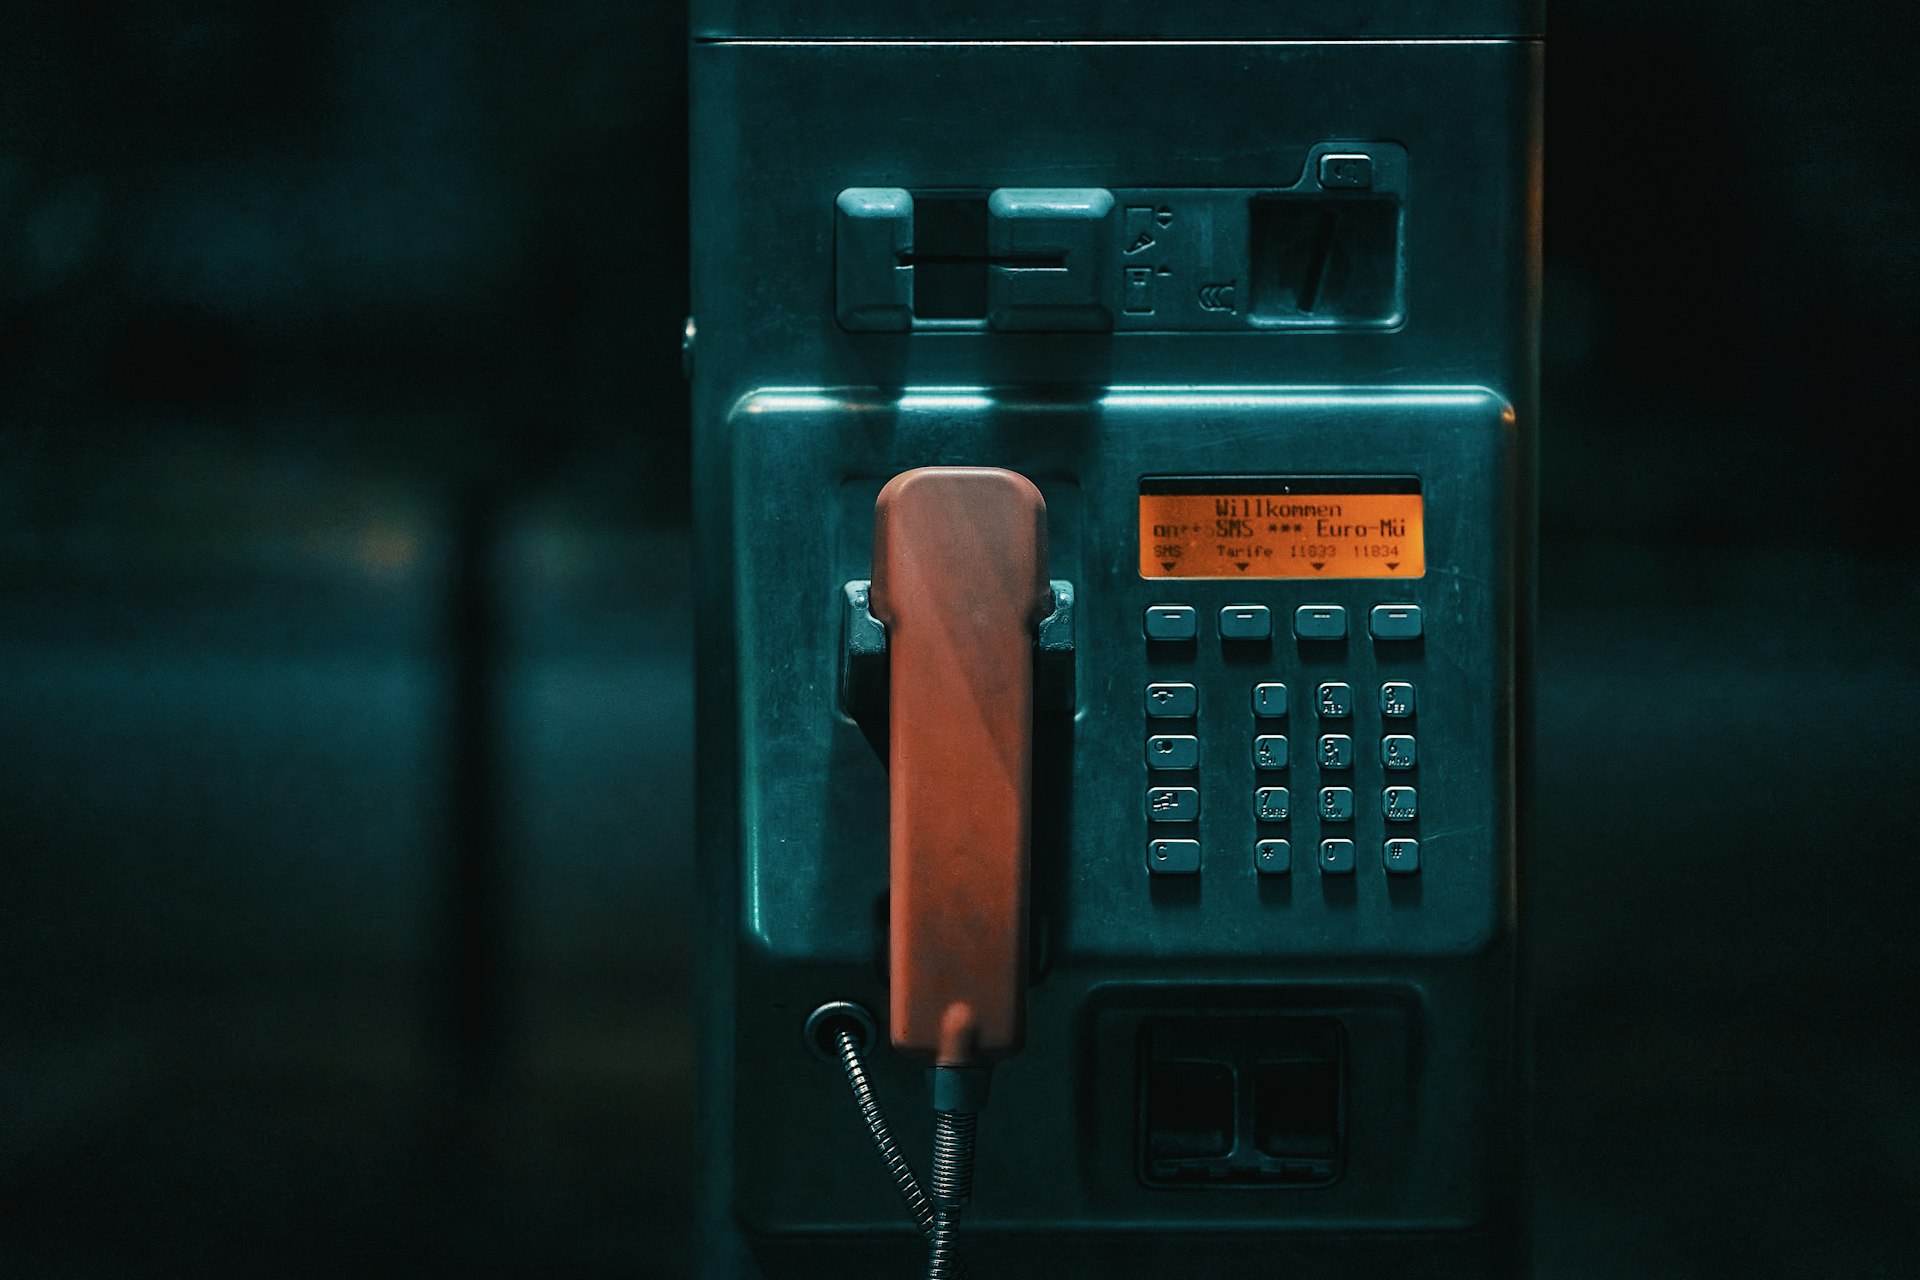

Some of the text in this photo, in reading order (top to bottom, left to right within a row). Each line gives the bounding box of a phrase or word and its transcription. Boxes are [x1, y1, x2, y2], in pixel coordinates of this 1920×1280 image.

[1216, 498, 1342, 518] Willkommen
[1216, 518, 1255, 538] SMS
[1316, 518, 1406, 538] Euro-Mü
[1153, 544, 1399, 558] SMS Tarife 11833 11834
[1260, 687, 1267, 705] 1
[1322, 687, 1334, 705] 2
[1385, 687, 1396, 705] 3
[1259, 739, 1271, 757] 4
[1324, 739, 1335, 757] 5
[1388, 739, 1398, 757] 6
[1260, 790, 1272, 808] 7
[1324, 790, 1335, 808] 8
[1388, 790, 1399, 808] 9
[1156, 844, 1168, 861] C
[1325, 844, 1336, 861] 0
